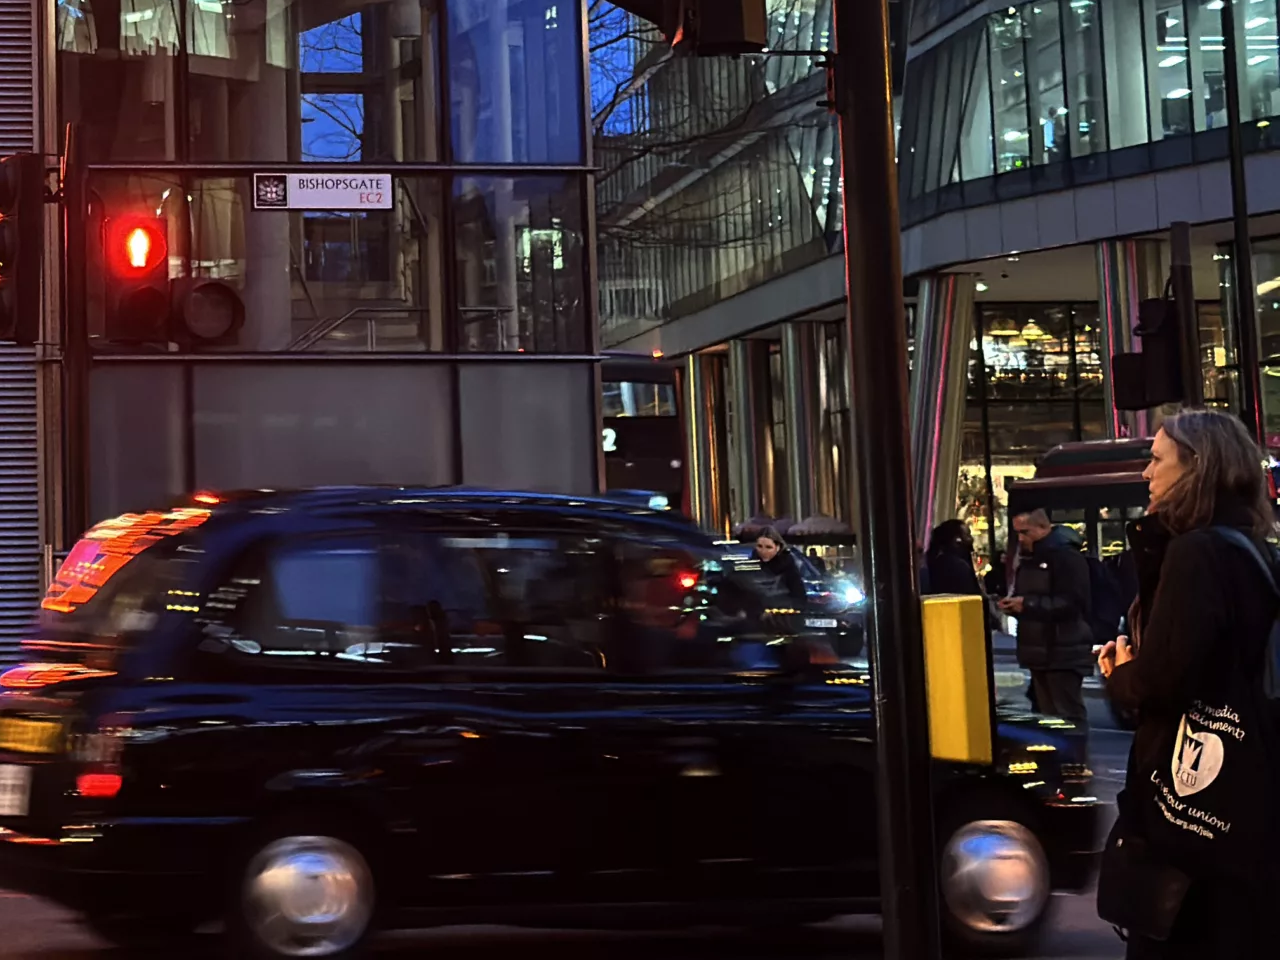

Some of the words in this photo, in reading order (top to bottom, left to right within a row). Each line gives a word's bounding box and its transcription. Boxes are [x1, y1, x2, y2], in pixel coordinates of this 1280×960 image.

[298, 178, 383, 190] BISHOPSGATE
[359, 192, 383, 204] EC2
[1205, 704, 1240, 723] media
[1187, 805, 1231, 833] union!
